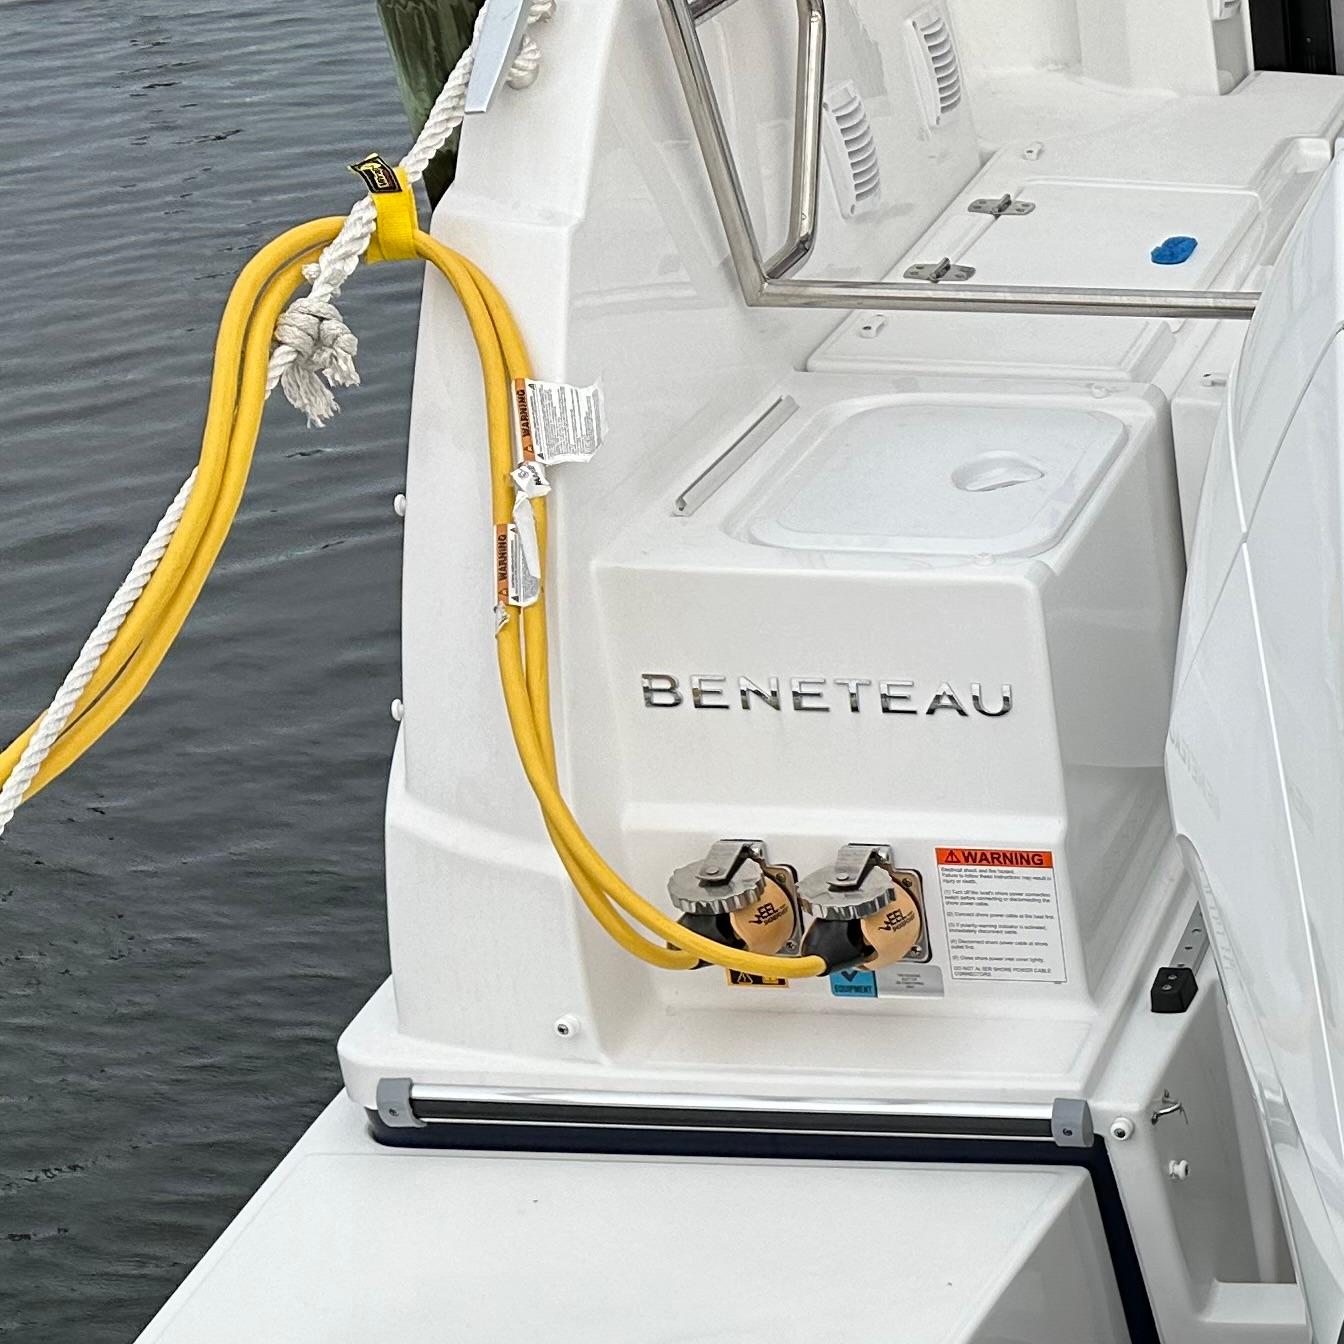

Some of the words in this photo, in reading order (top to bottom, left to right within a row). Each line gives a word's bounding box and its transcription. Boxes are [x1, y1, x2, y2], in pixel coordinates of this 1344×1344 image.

[516, 389, 532, 438] WARNING
[497, 533, 507, 582] WARNING
[641, 673, 1013, 717] BENETEAU
[962, 851, 1044, 866] WARNING
[835, 985, 873, 993] EQUIPMENT
